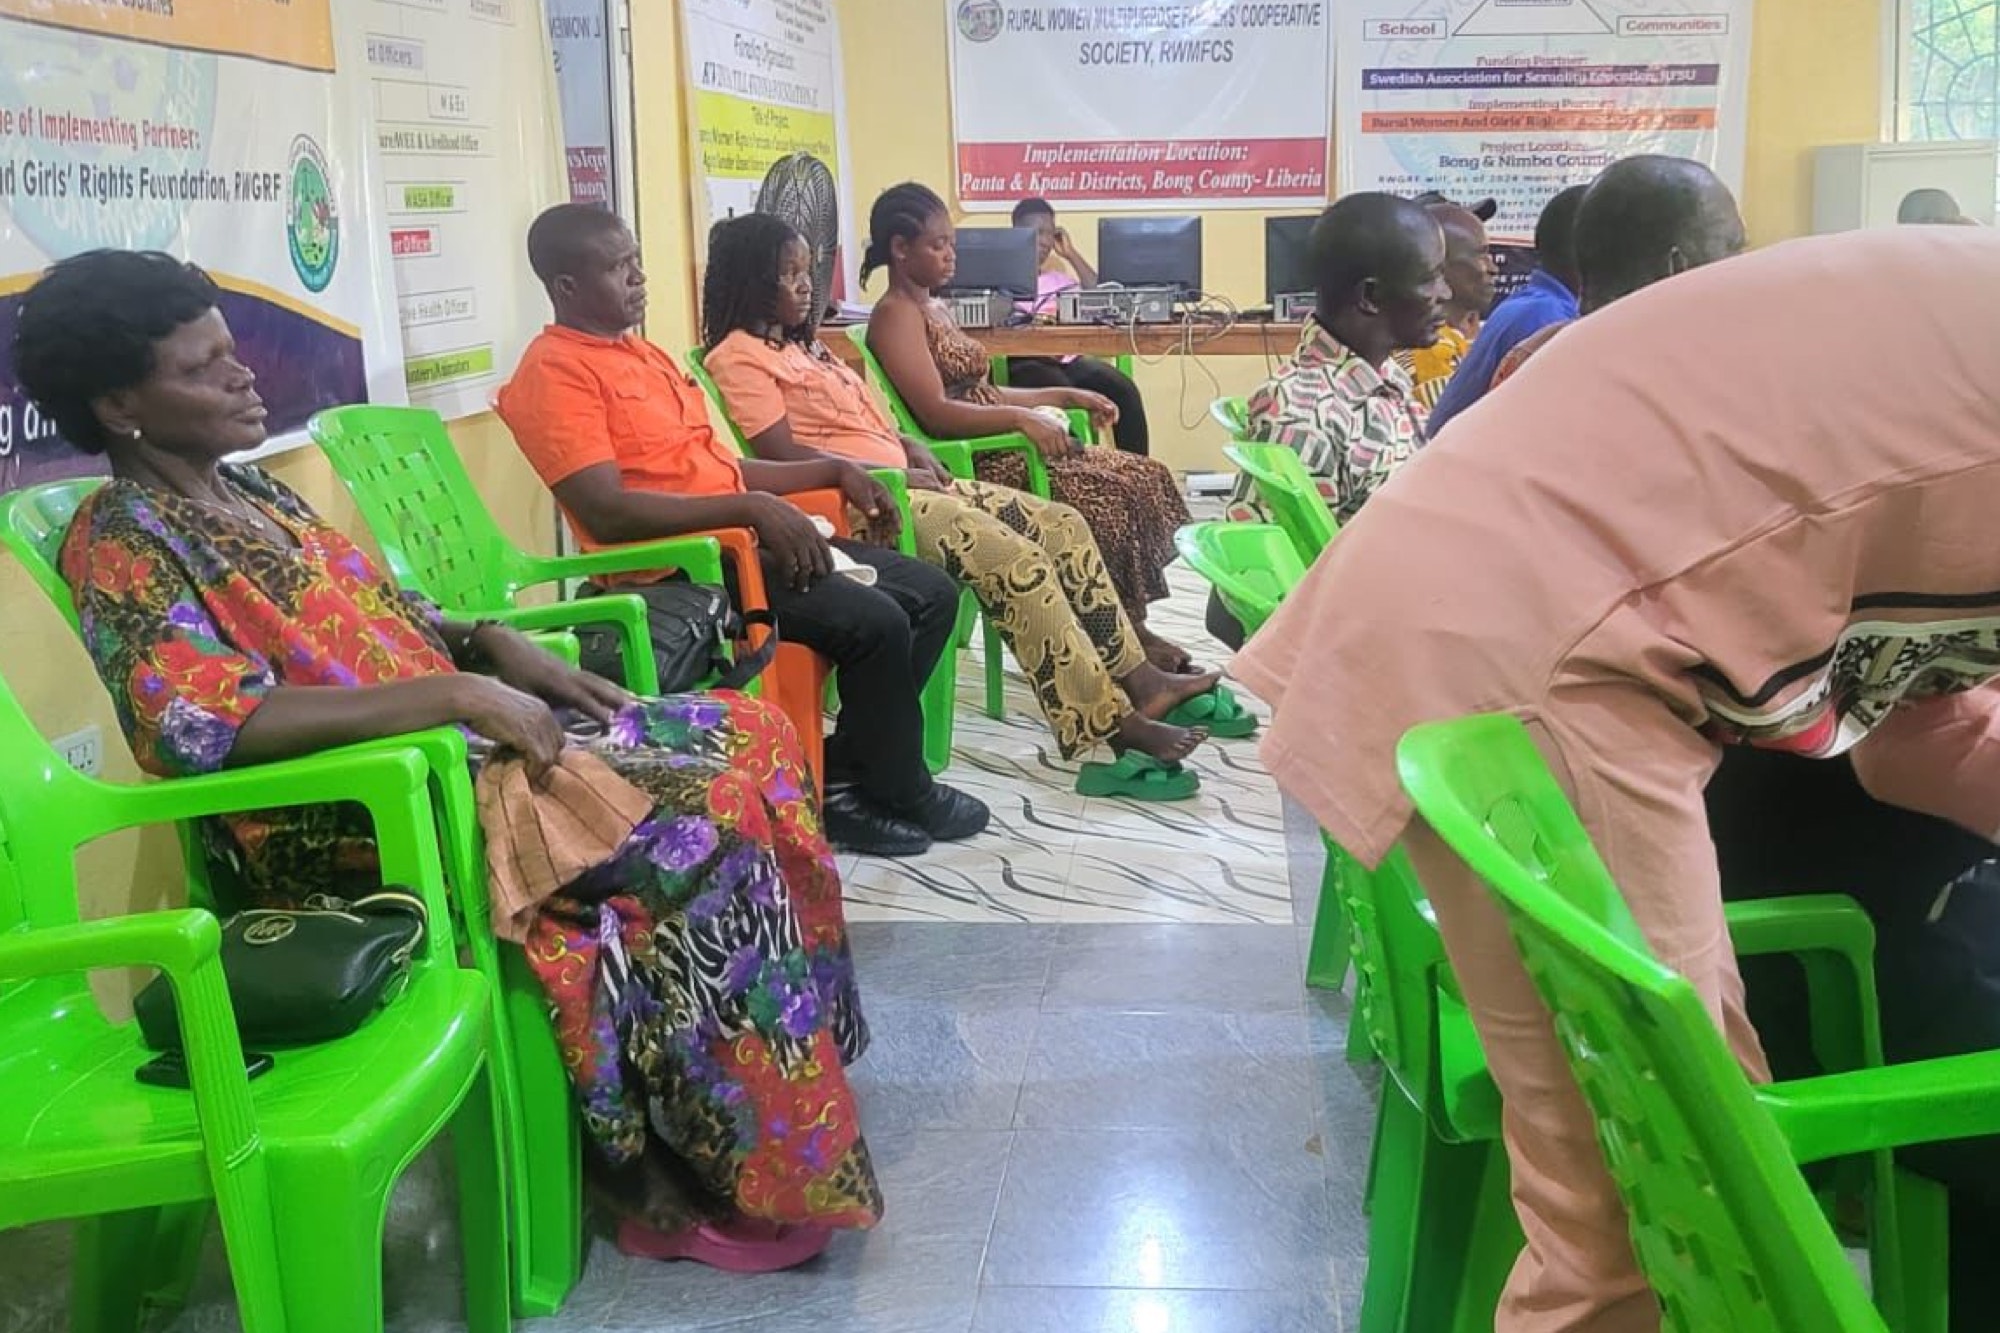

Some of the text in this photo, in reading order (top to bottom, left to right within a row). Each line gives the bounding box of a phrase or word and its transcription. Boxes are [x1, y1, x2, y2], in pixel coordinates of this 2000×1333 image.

[1006, 8, 1044, 32] RURAL
[1048, 7, 1091, 31] WOMEN
[1241, 3, 1321, 27] COOPERATIVE
[1626, 19, 1722, 32] Communities
[1378, 23, 1436, 36] School
[1079, 40, 1234, 65] SOCIETY, RWMFCS
[1476, 55, 1529, 68] Funding
[1370, 73, 1424, 85] Swedish
[1426, 71, 1500, 85] Association
[1502, 71, 1525, 83] for
[1468, 98, 1559, 113] Implementing
[19, 105, 33, 136] of
[38, 107, 138, 150] Implementing
[143, 119, 200, 149] Partner:
[1462, 115, 1488, 127] And
[1023, 143, 1249, 168] Implementation Location:
[1480, 142, 1526, 156] Project
[1439, 155, 1481, 170] Bong
[1483, 154, 1496, 168] &
[1499, 153, 1552, 167] Nimba
[23, 160, 72, 199] Girls'
[79, 164, 134, 205] Rights
[139, 166, 230, 203] Foundation,
[234, 171, 282, 202] RWGRF
[961, 173, 1006, 192] Panta
[1009, 172, 1022, 191] &
[1029, 171, 1075, 196] Kpaai
[1078, 170, 1148, 193] Districts,
[1152, 169, 1194, 194] Bong
[1265, 167, 1322, 188] Liberia
